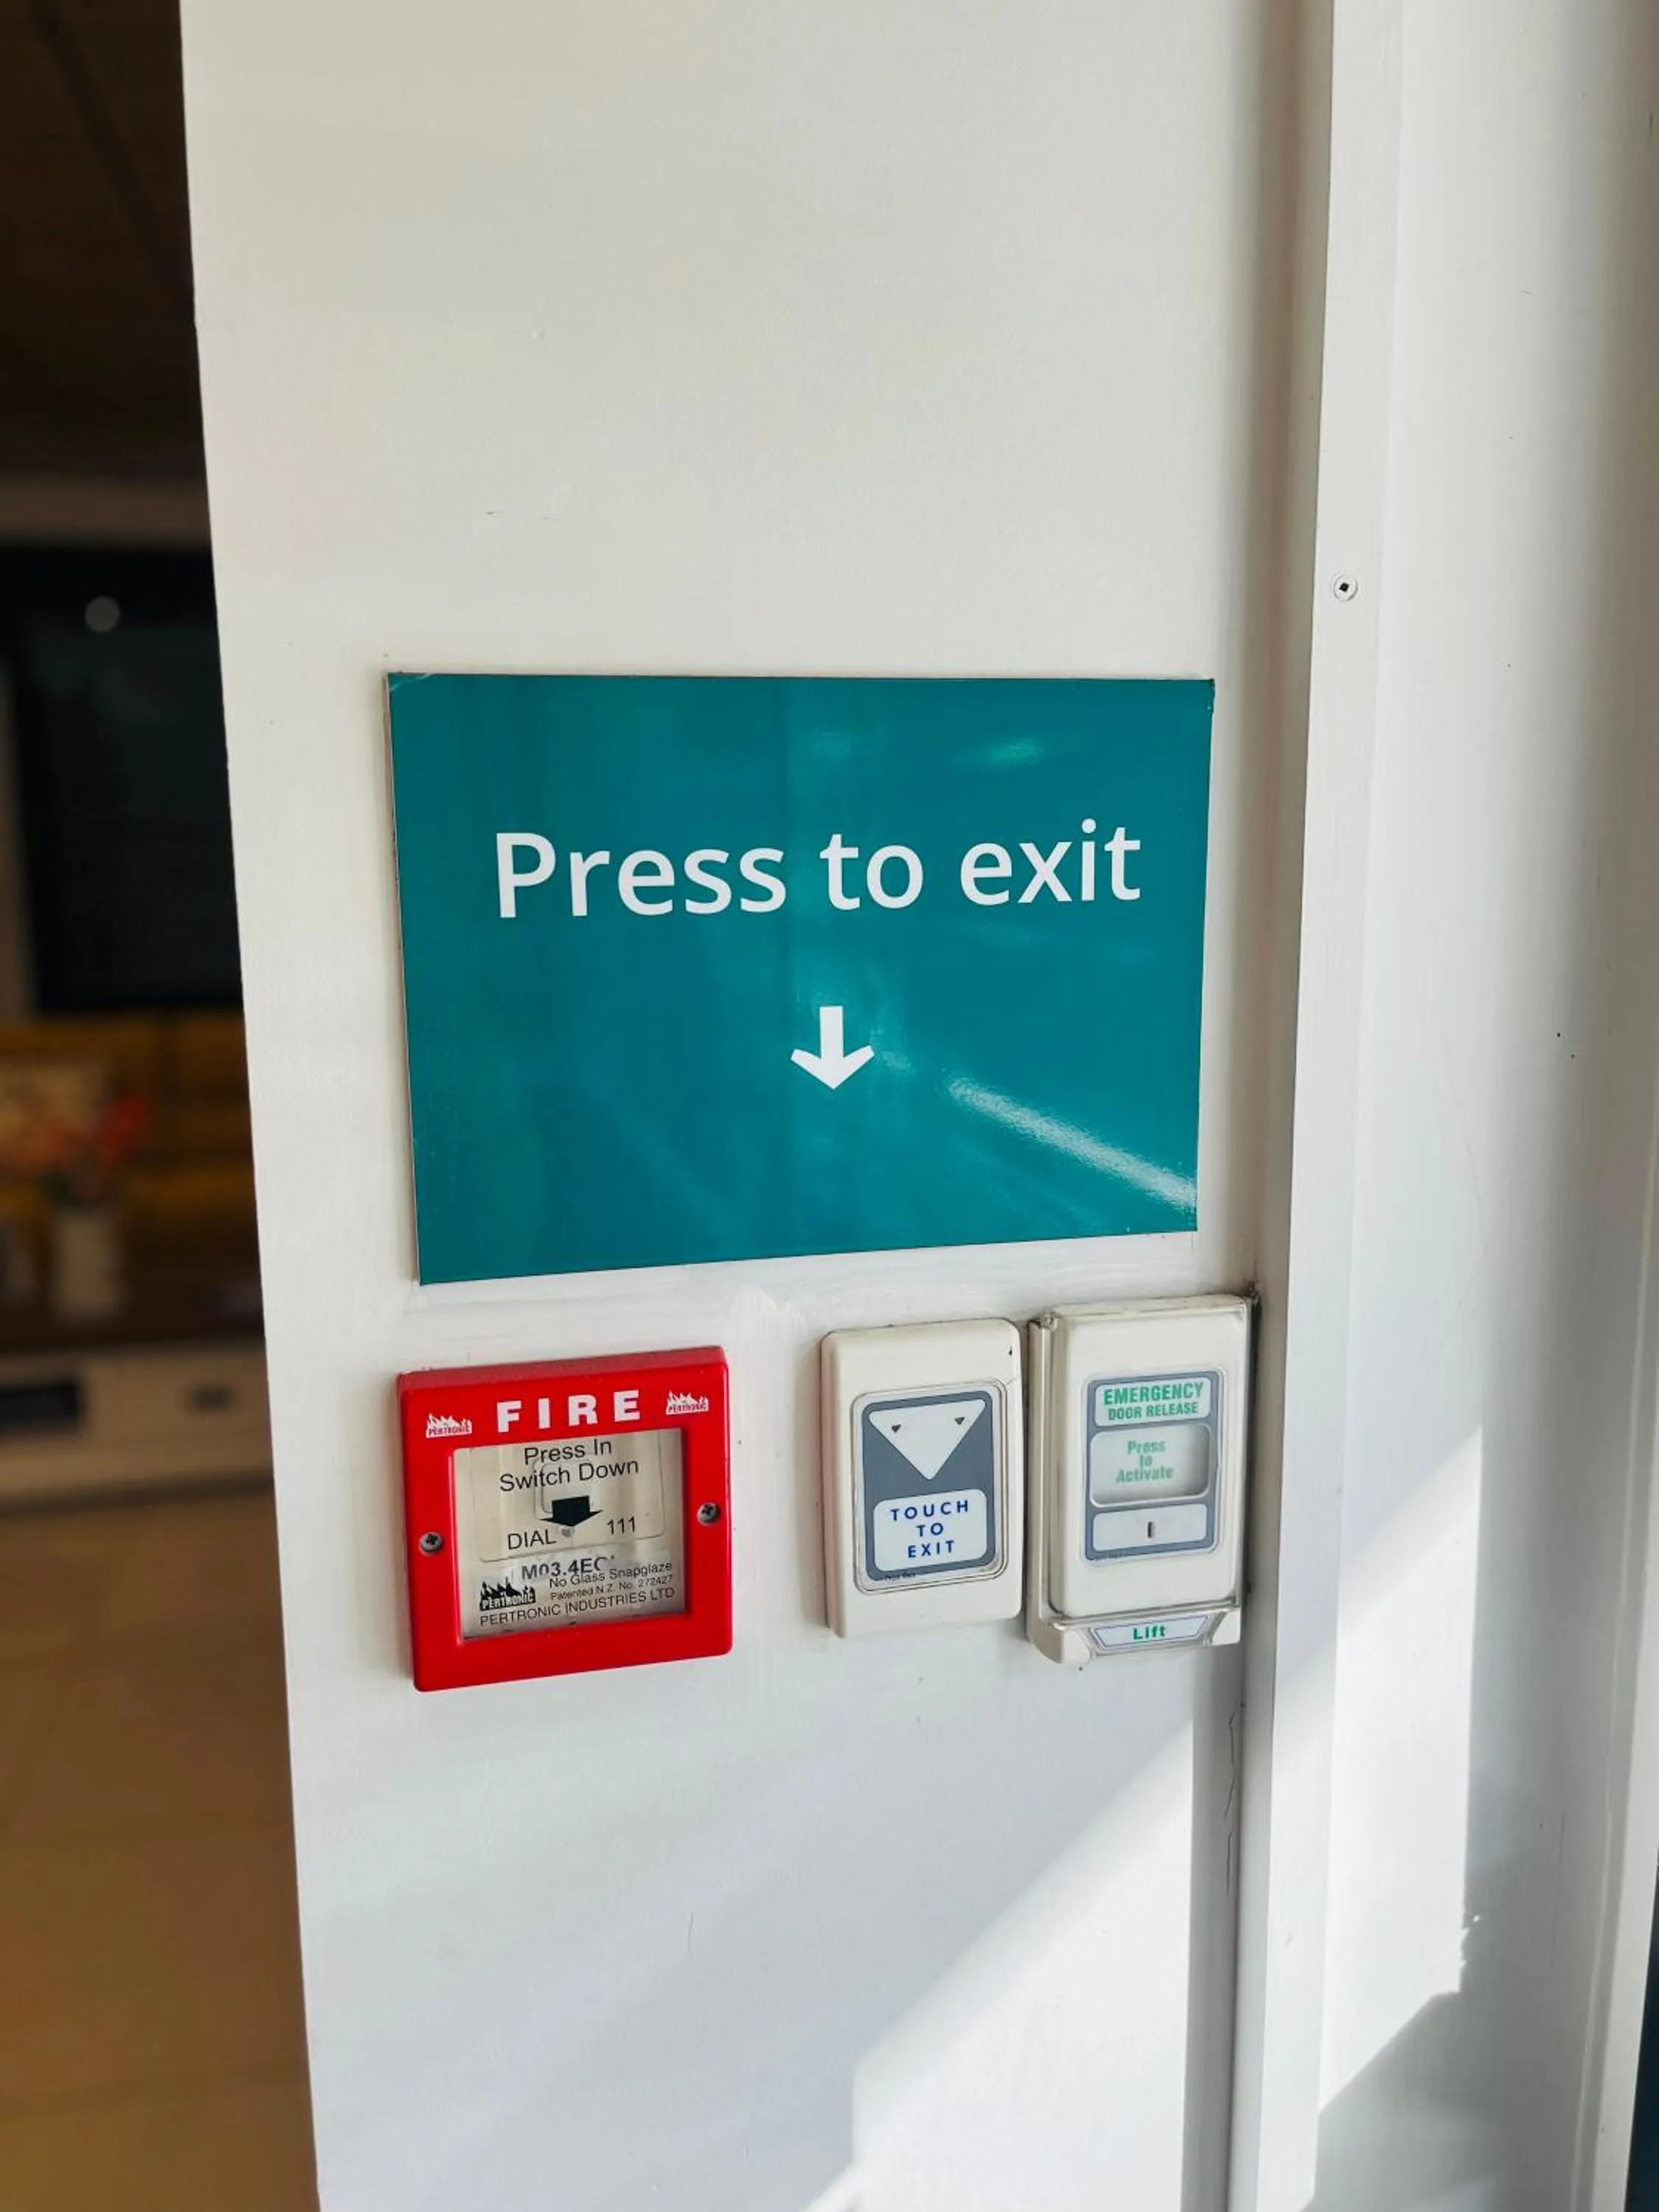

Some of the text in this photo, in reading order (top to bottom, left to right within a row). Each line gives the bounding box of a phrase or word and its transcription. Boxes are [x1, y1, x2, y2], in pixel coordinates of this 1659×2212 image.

[495, 818, 1141, 919] Press to exit
[1104, 1382, 1204, 1405] EMERGENCY
[497, 1389, 641, 1433] FIRE
[1108, 1402, 1199, 1421] DOOR RELEASE
[524, 1439, 612, 1465] Press In
[1127, 1440, 1166, 1455] Press
[499, 1460, 639, 1492] Switch Down
[1116, 1467, 1175, 1484] Activate
[890, 1499, 969, 1522] TOUCH
[507, 1516, 636, 1550] DIAL 111
[916, 1522, 944, 1537] TO
[907, 1539, 954, 1558] EXIT
[549, 1562, 672, 1588] No Glass Snapglaze
[480, 1586, 675, 1627] PERTRONIC INDUSTRIES LTD
[1133, 1624, 1166, 1641] Lift
